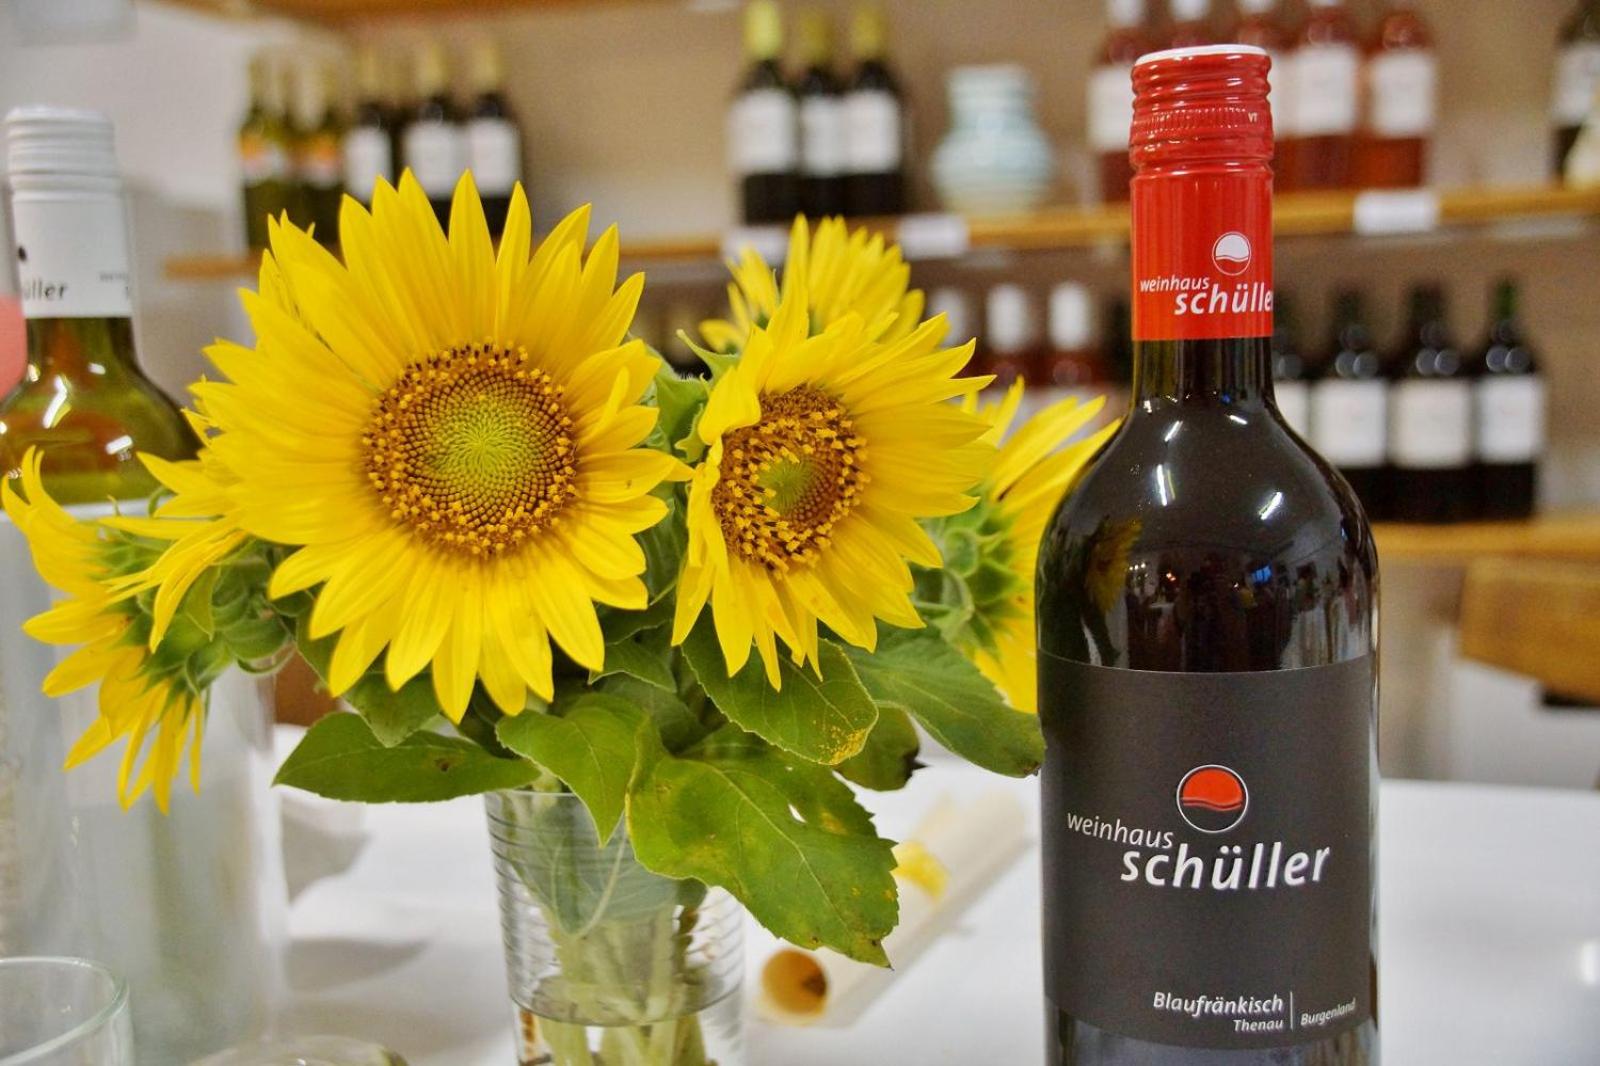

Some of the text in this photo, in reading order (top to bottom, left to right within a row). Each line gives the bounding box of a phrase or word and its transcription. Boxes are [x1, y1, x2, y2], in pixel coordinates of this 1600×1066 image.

[1140, 274, 1210, 292] weinhaus
[1174, 281, 1273, 315] schülle
[1067, 812, 1174, 849] weinhaus
[1120, 841, 1330, 890] schüller
[1152, 991, 1284, 1018] Blaufränkisch
[1300, 996, 1356, 1026] Burgenland
[1232, 1018, 1284, 1033] Thenau
